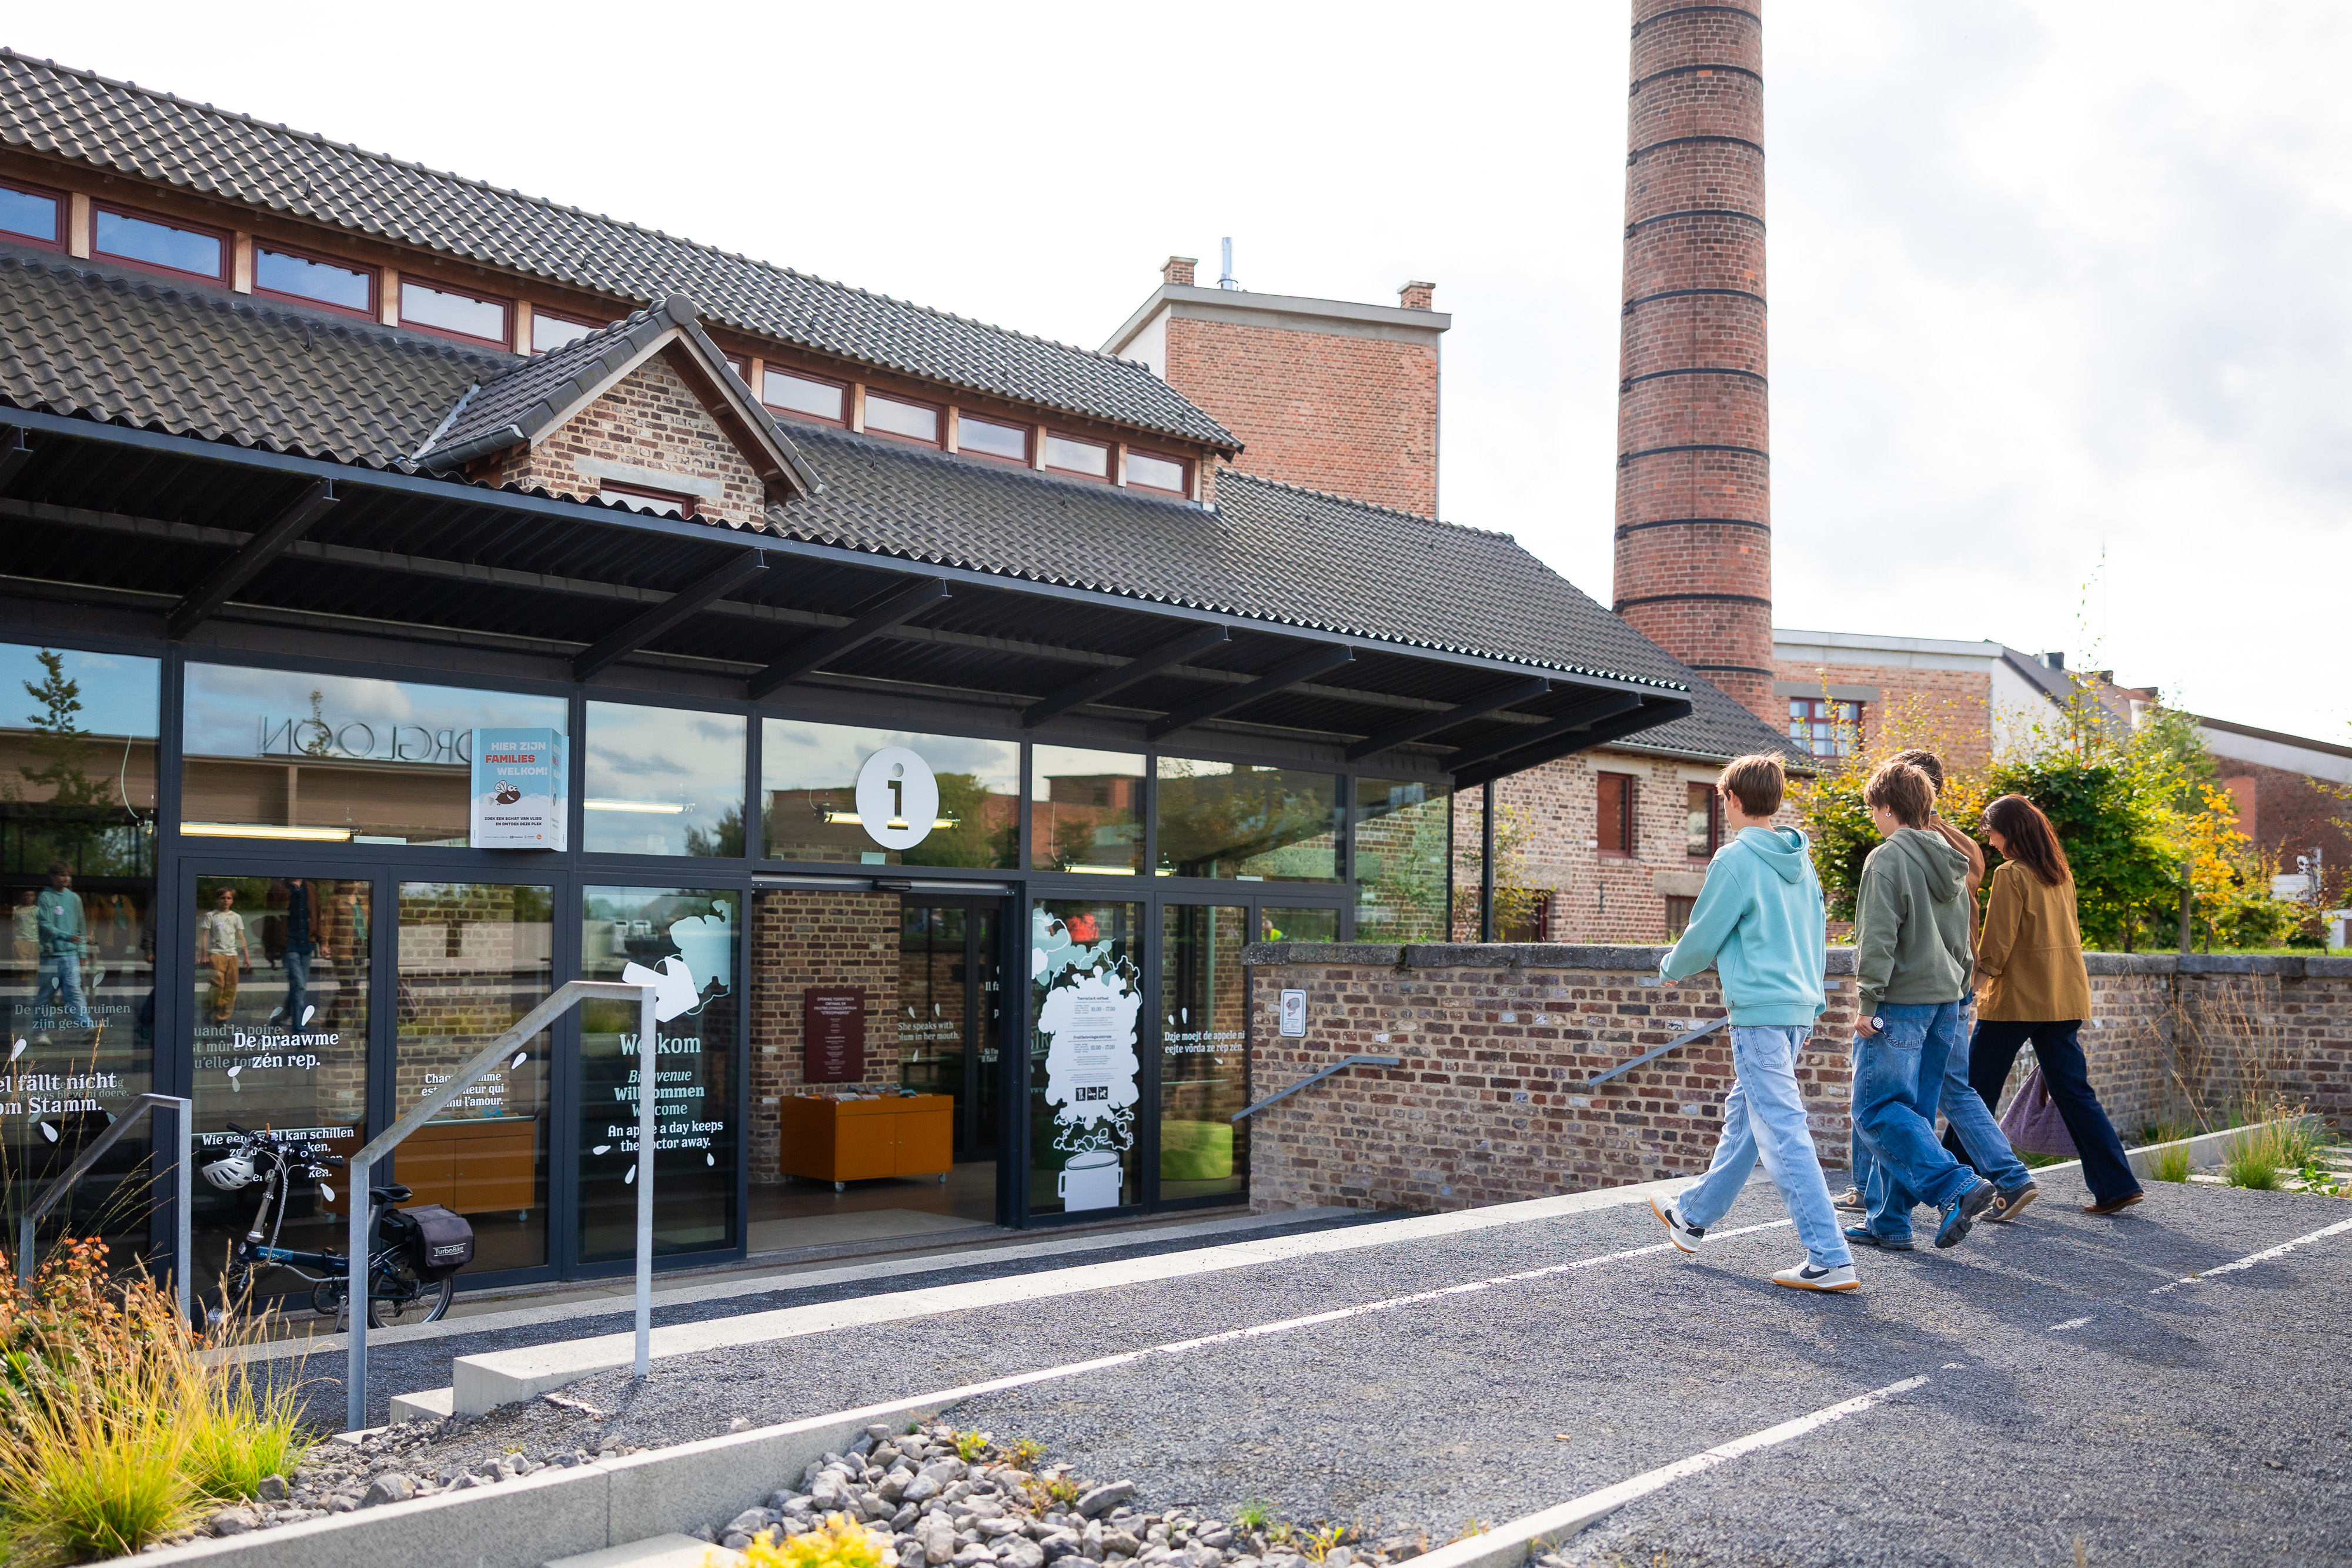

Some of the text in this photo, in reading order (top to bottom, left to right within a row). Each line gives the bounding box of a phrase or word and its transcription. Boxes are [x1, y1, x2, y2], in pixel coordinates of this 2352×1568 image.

[491, 741, 546, 751] HIER ZIJN
[485, 754, 536, 763] FAMILIES
[497, 767, 547, 775] WELKOM!
[887, 763, 909, 830] i
[15, 1004, 131, 1017] De rijpste pruimen
[32, 1017, 113, 1031] zijn geschud.
[898, 1021, 954, 1032] She speaks with
[194, 1024, 227, 1037] uand
[248, 1024, 282, 1038] poire
[916, 1032, 922, 1041] in
[924, 1032, 936, 1041] her
[937, 1031, 960, 1040] mouth.
[1203, 1030, 1212, 1040] de
[1213, 1030, 1237, 1042] appele
[1238, 1030, 1245, 1039] ni
[234, 1033, 256, 1048] De
[261, 1033, 339, 1051] praawme
[619, 1032, 701, 1055] Wekom
[195, 1056, 230, 1069] u’elle
[252, 1052, 282, 1068] zén
[288, 1054, 320, 1070] rep.
[18, 1074, 61, 1092] fällt
[66, 1072, 117, 1091] nicht
[628, 1070, 691, 1083] Bivenue
[489, 1084, 505, 1095] qui
[614, 1086, 704, 1101] Willommen
[29, 1097, 102, 1114] Stamm.
[632, 1104, 687, 1117] Wcome
[608, 1120, 724, 1138] An ape a day keeps
[202, 1134, 224, 1145] Wie
[286, 1130, 308, 1141] kan
[309, 1128, 354, 1140] schillen
[620, 1137, 711, 1152] the octor away.
[435, 1246, 463, 1255] TurboBike
